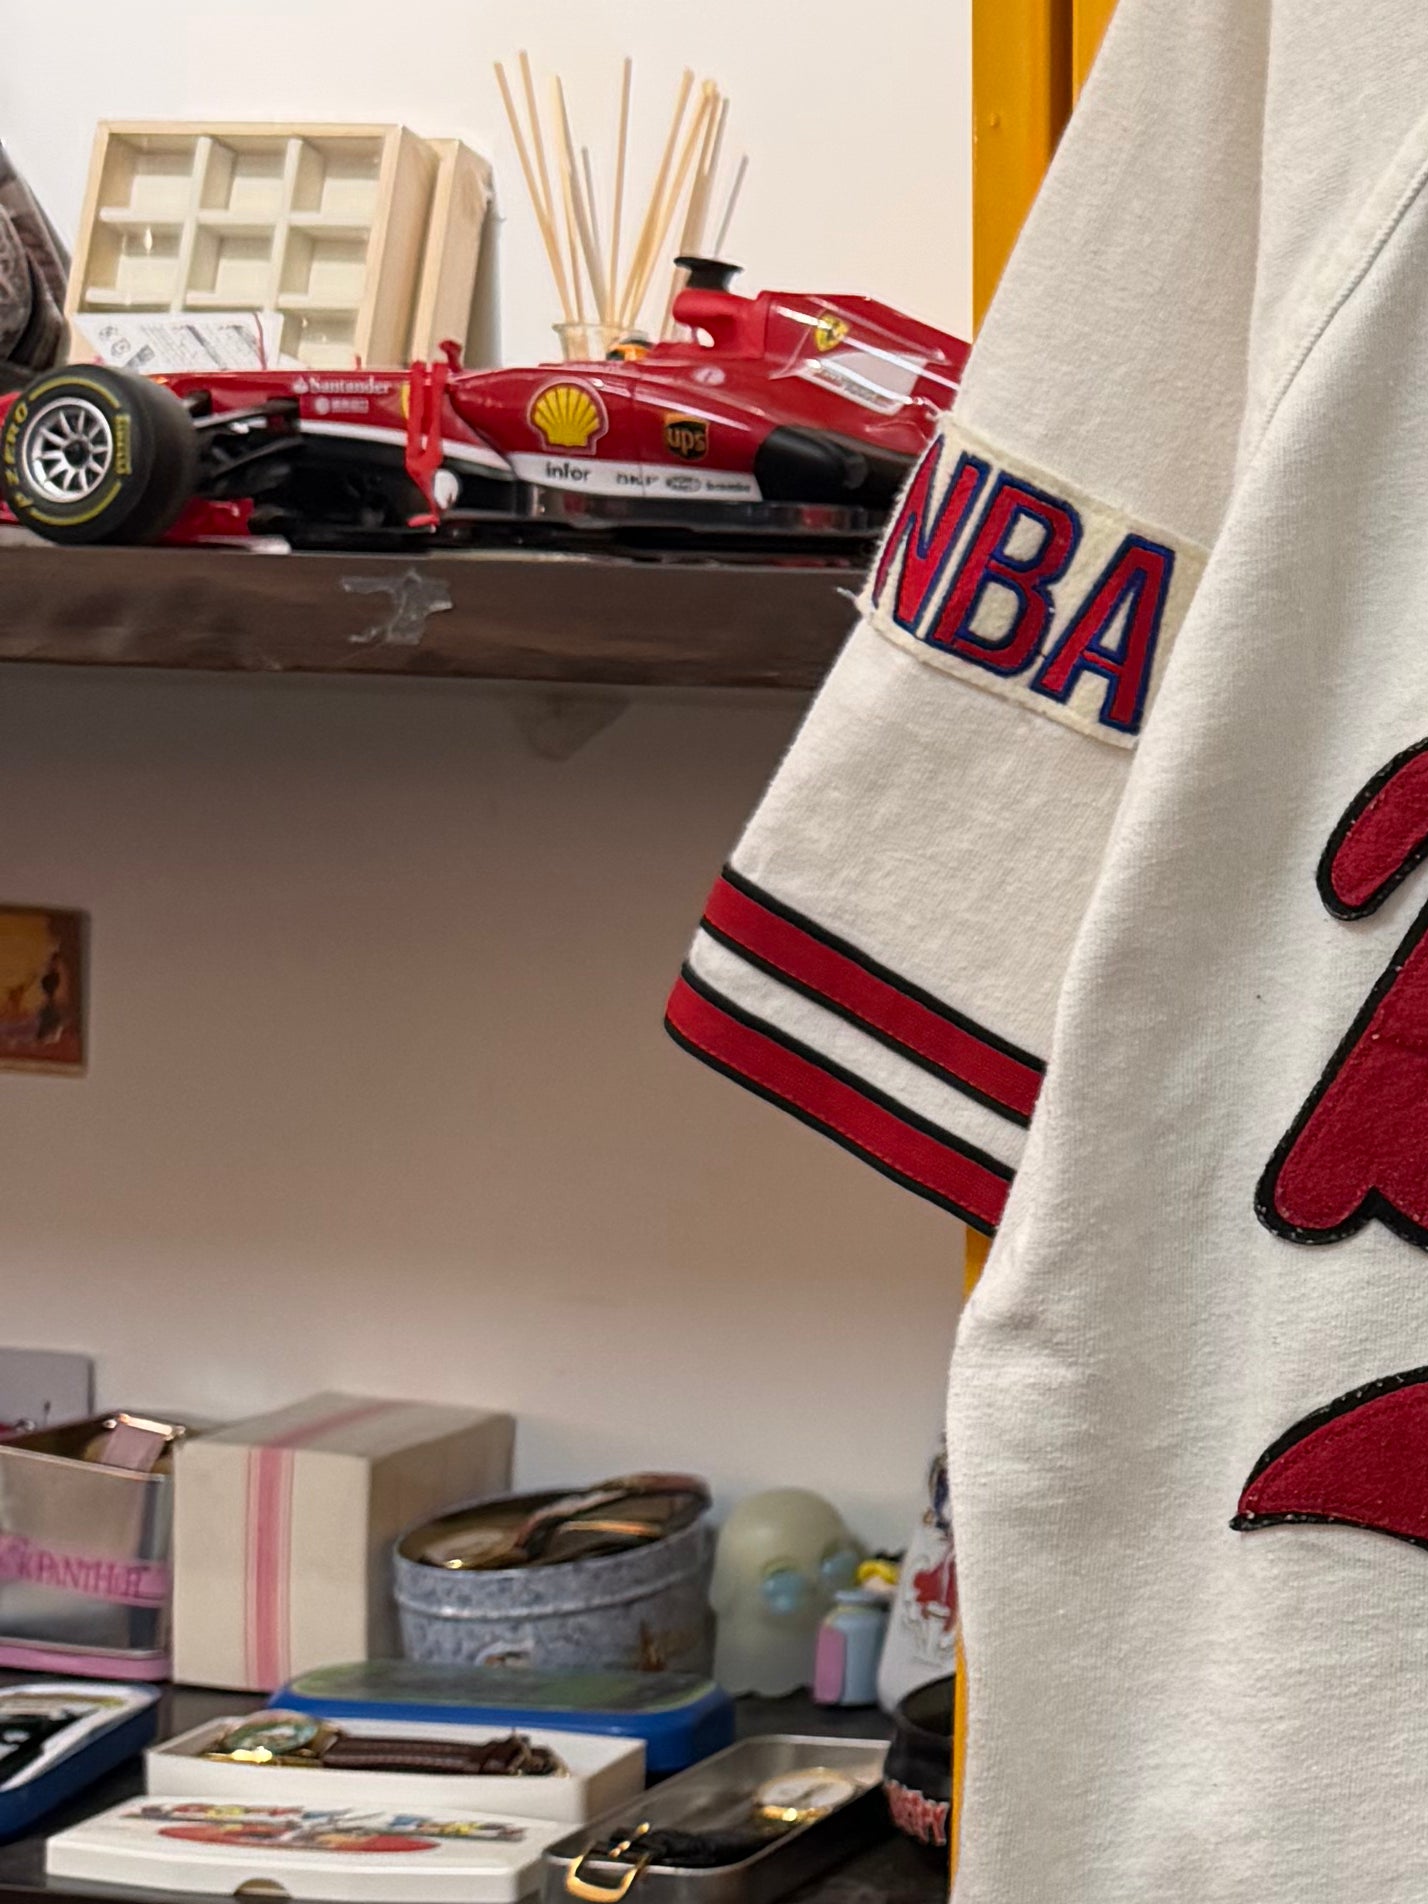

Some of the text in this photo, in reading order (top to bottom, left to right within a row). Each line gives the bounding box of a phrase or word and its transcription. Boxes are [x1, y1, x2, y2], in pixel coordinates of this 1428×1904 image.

[309, 376, 391, 394] Santander
[667, 429, 705, 455] ups
[546, 463, 591, 482] infor
[872, 433, 1176, 736] NBA
